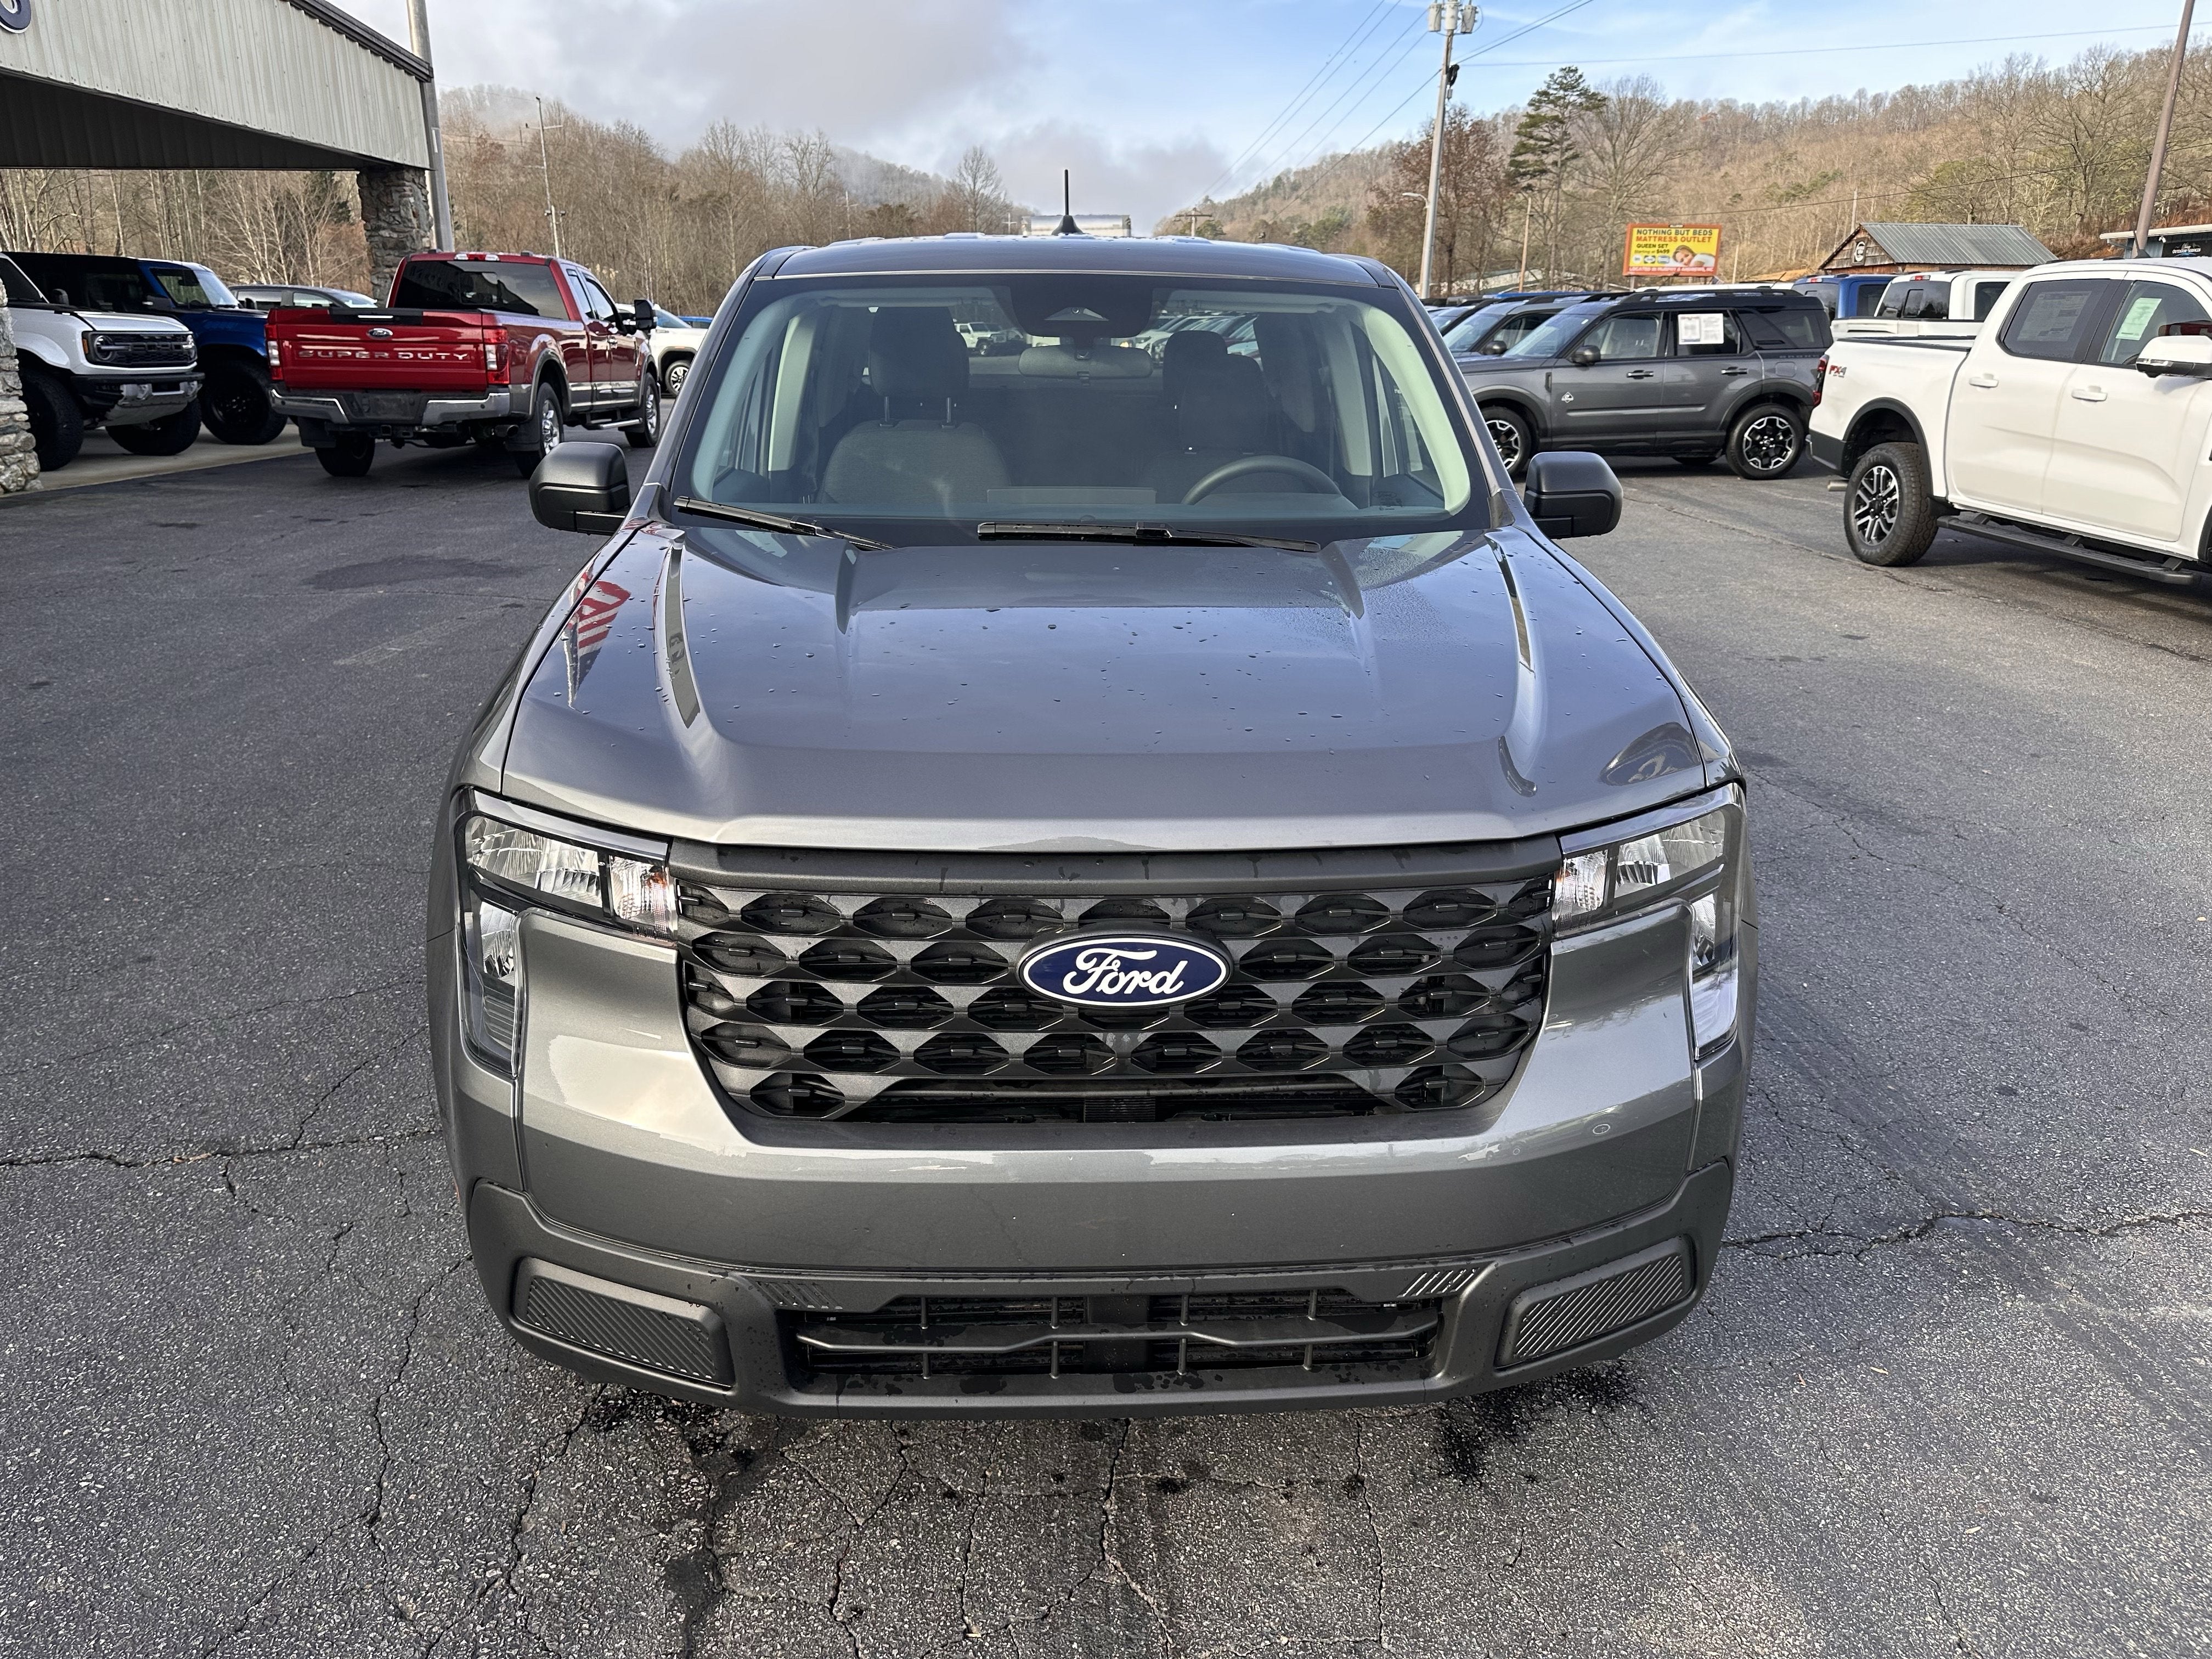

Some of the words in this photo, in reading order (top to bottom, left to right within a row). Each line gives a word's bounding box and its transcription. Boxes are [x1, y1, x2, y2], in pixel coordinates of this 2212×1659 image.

[298, 350, 390, 358] SUPER
[398, 352, 469, 360] DUTY
[1829, 365, 1847, 375] FX4
[1063, 947, 1188, 995] Ford
